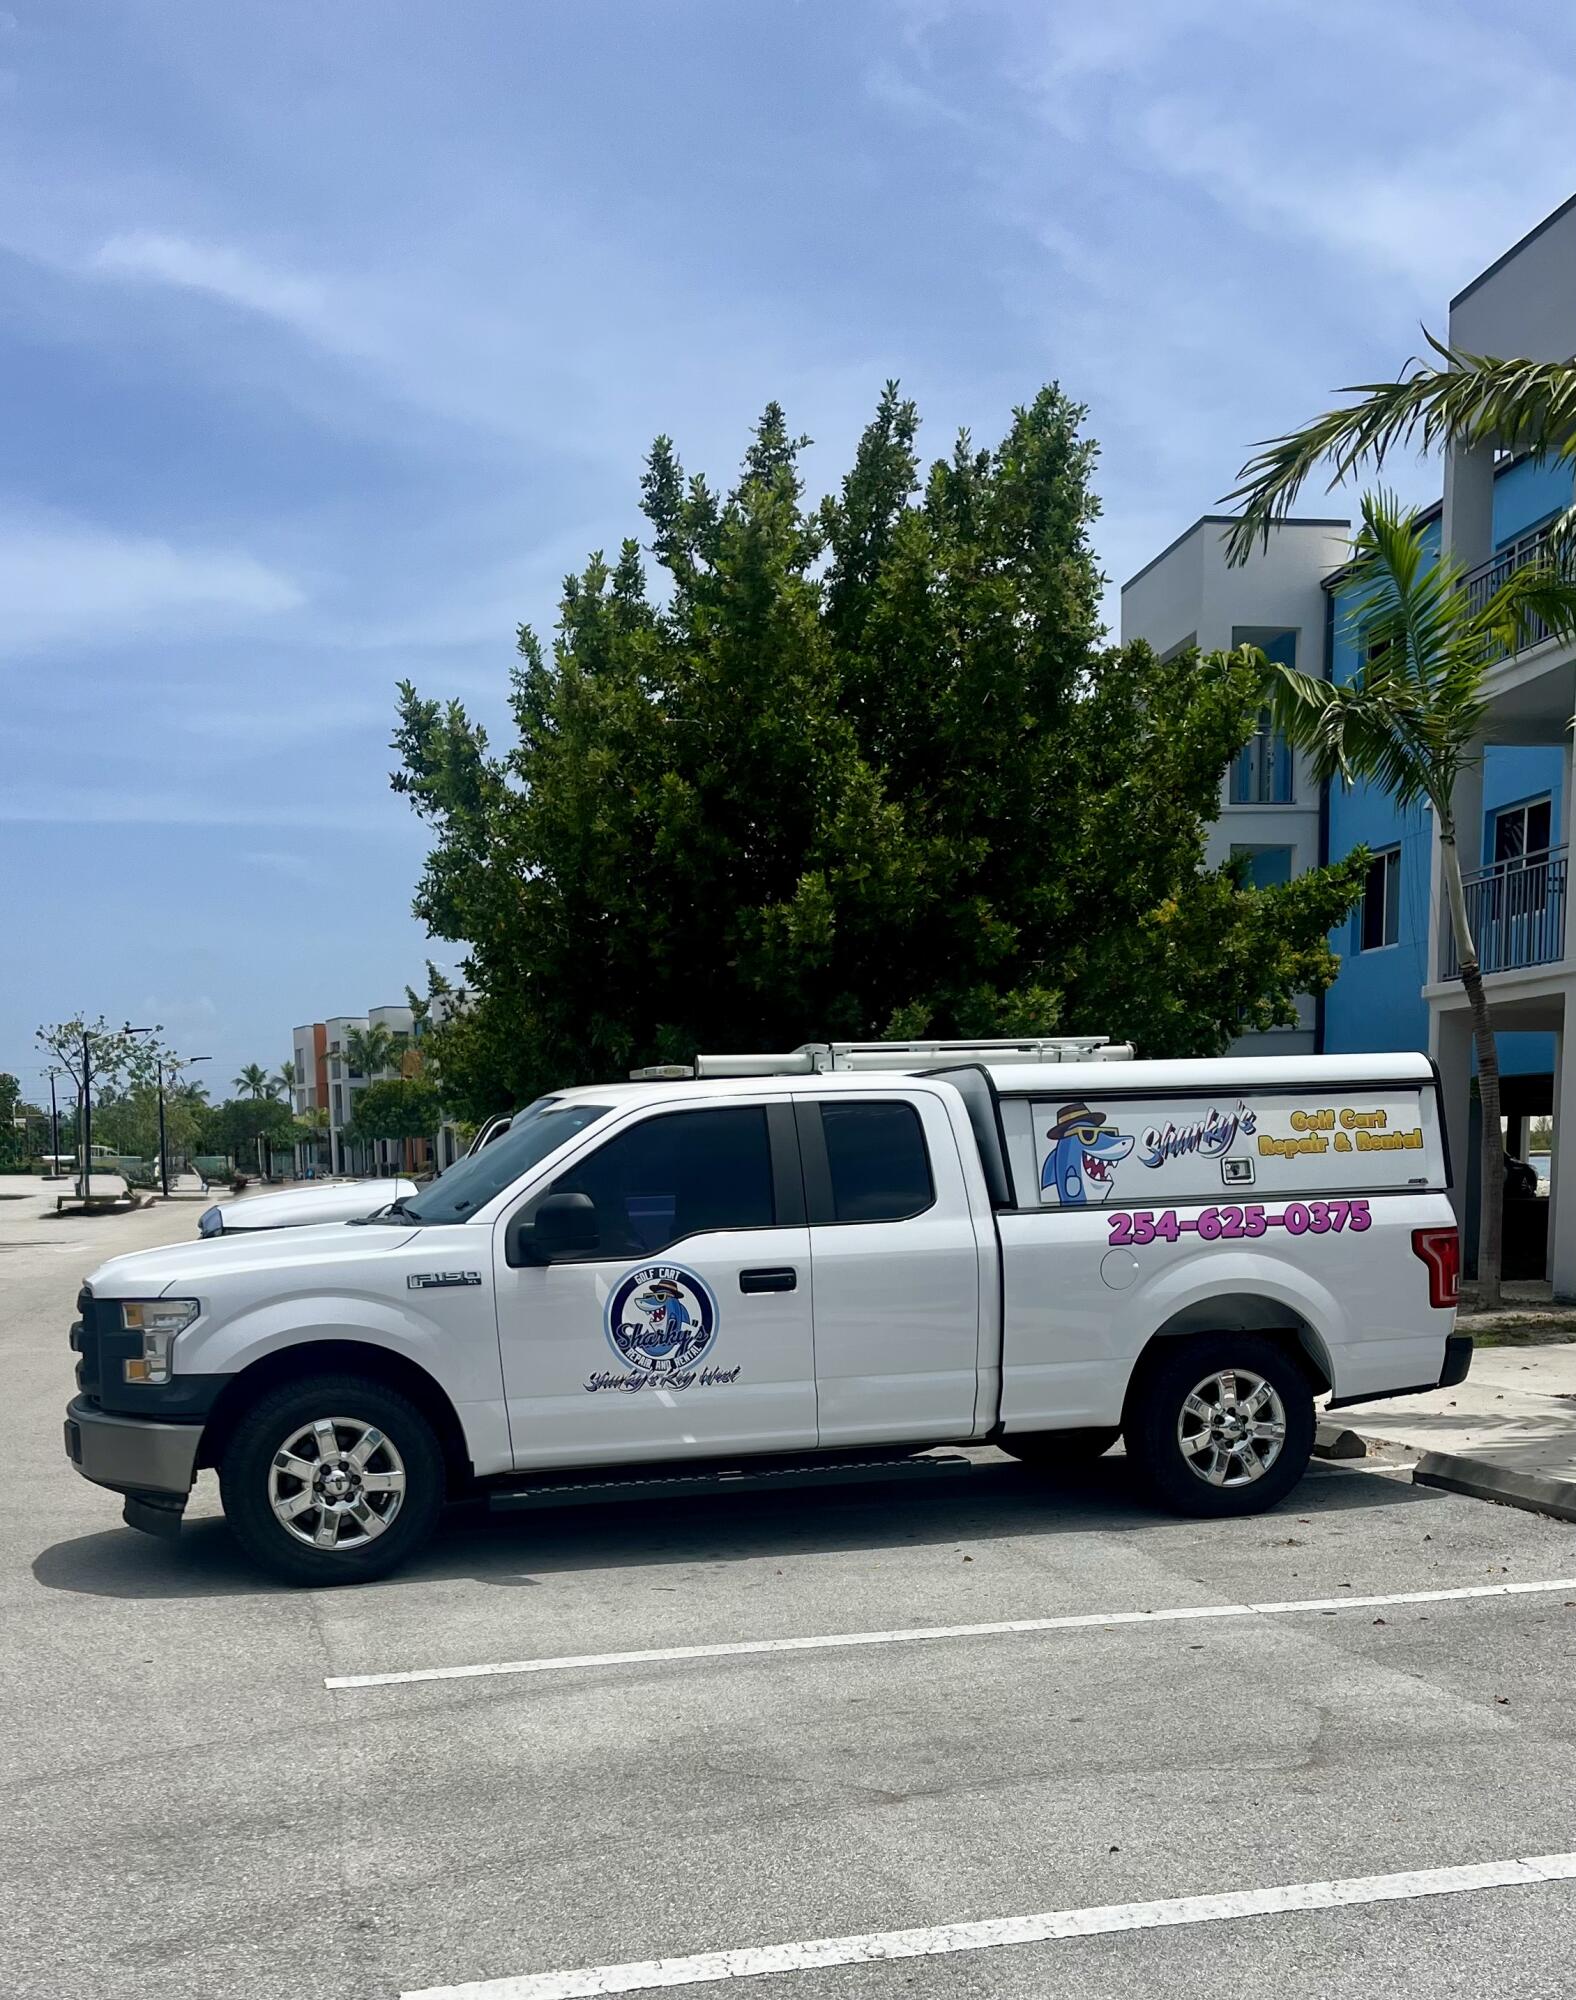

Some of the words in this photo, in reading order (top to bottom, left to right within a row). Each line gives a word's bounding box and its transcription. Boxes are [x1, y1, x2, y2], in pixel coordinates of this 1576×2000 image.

[1137, 1099, 1257, 1168] Sharky's
[1290, 1109, 1336, 1131] Golf
[1339, 1109, 1387, 1129] Cart
[1258, 1132, 1329, 1159] Repair
[1334, 1132, 1353, 1152] &
[1355, 1128, 1424, 1152] Rental
[1108, 1200, 1372, 1246] 254-625-0375
[633, 1269, 655, 1285] GOLF
[659, 1268, 681, 1281] CART
[616, 1319, 710, 1358] Sharky's
[625, 1348, 653, 1369] REPAIR
[655, 1360, 672, 1370] AND
[674, 1344, 702, 1368] RENTAL
[659, 1367, 697, 1393] Key
[699, 1365, 742, 1387] West
